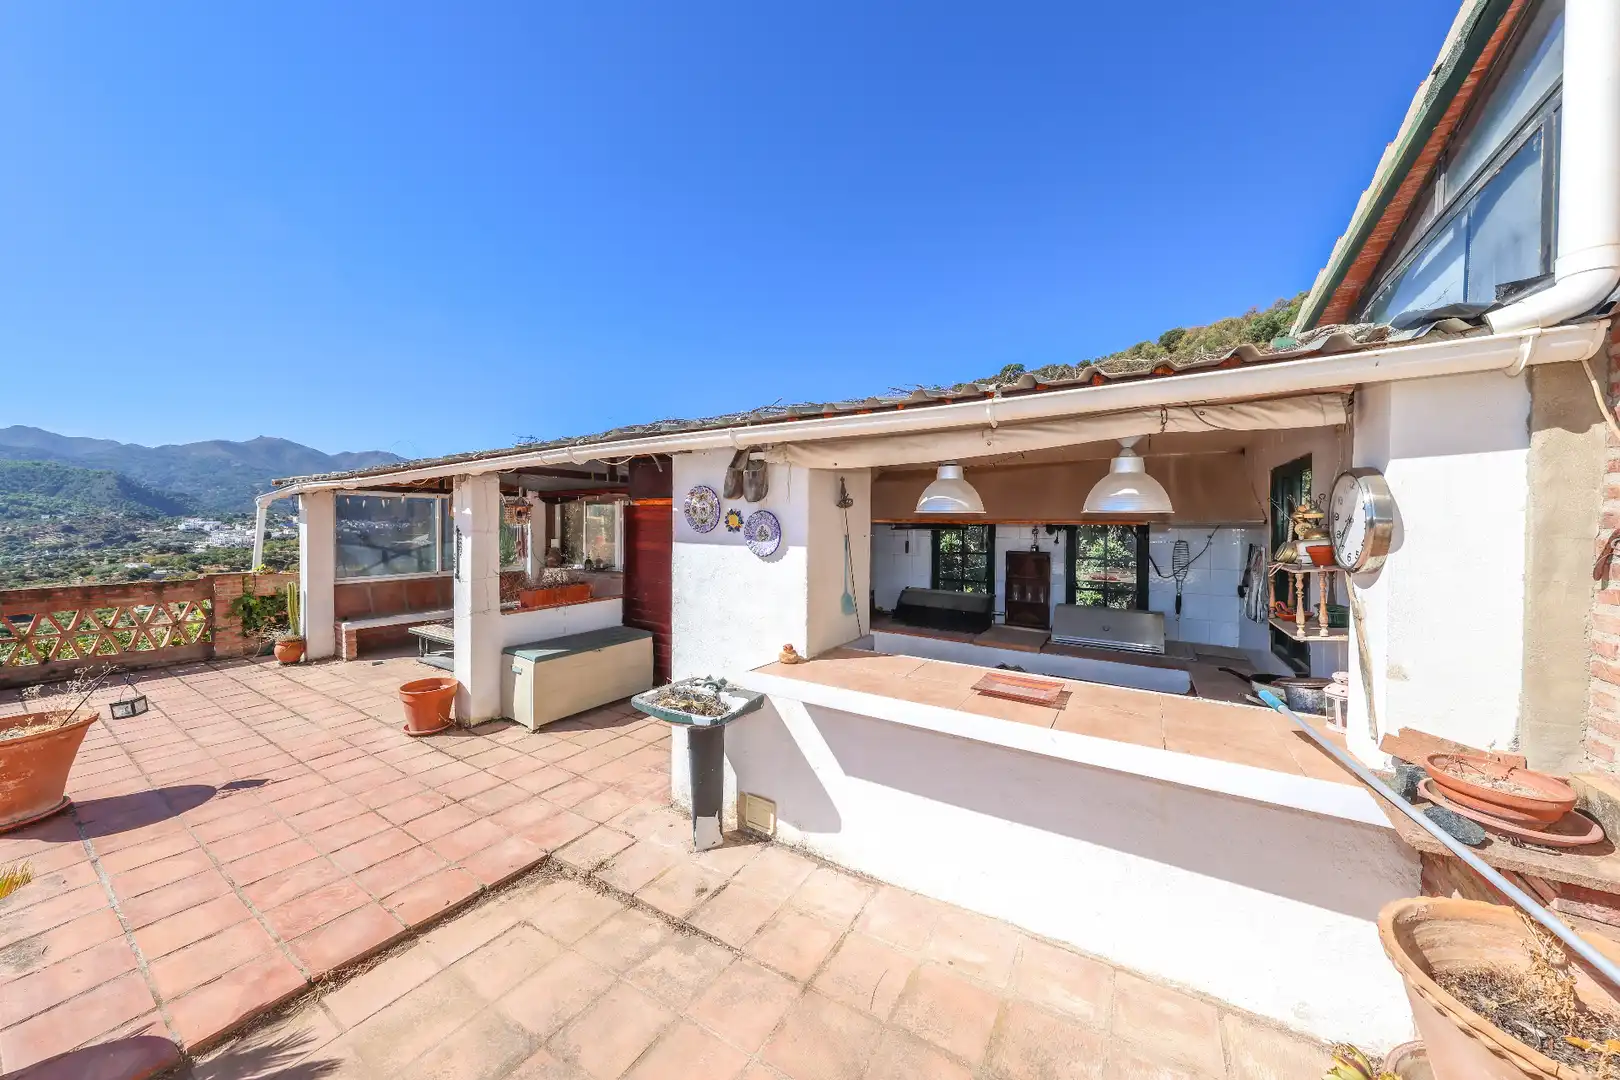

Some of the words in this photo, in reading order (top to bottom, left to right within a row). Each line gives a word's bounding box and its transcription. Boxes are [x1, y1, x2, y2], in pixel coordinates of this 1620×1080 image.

[1335, 512, 1340, 521] 9
[1336, 530, 1341, 539] 8
[1347, 552, 1352, 562] 6
[1355, 550, 1360, 560] 5
